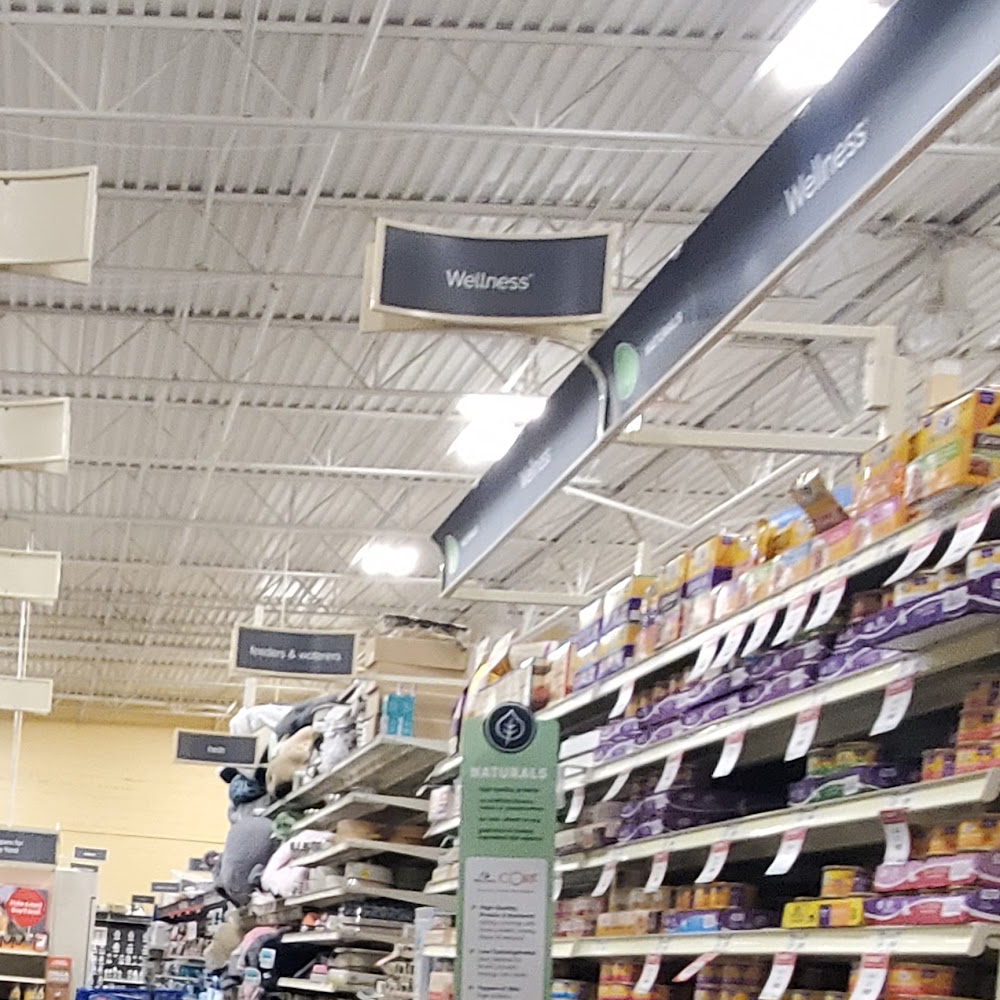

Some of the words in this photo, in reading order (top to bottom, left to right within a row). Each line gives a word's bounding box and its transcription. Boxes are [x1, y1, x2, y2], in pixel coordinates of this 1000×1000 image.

[783, 119, 868, 216] Wellness
[445, 269, 531, 291] Wellness
[470, 767, 548, 779] NATURALS
